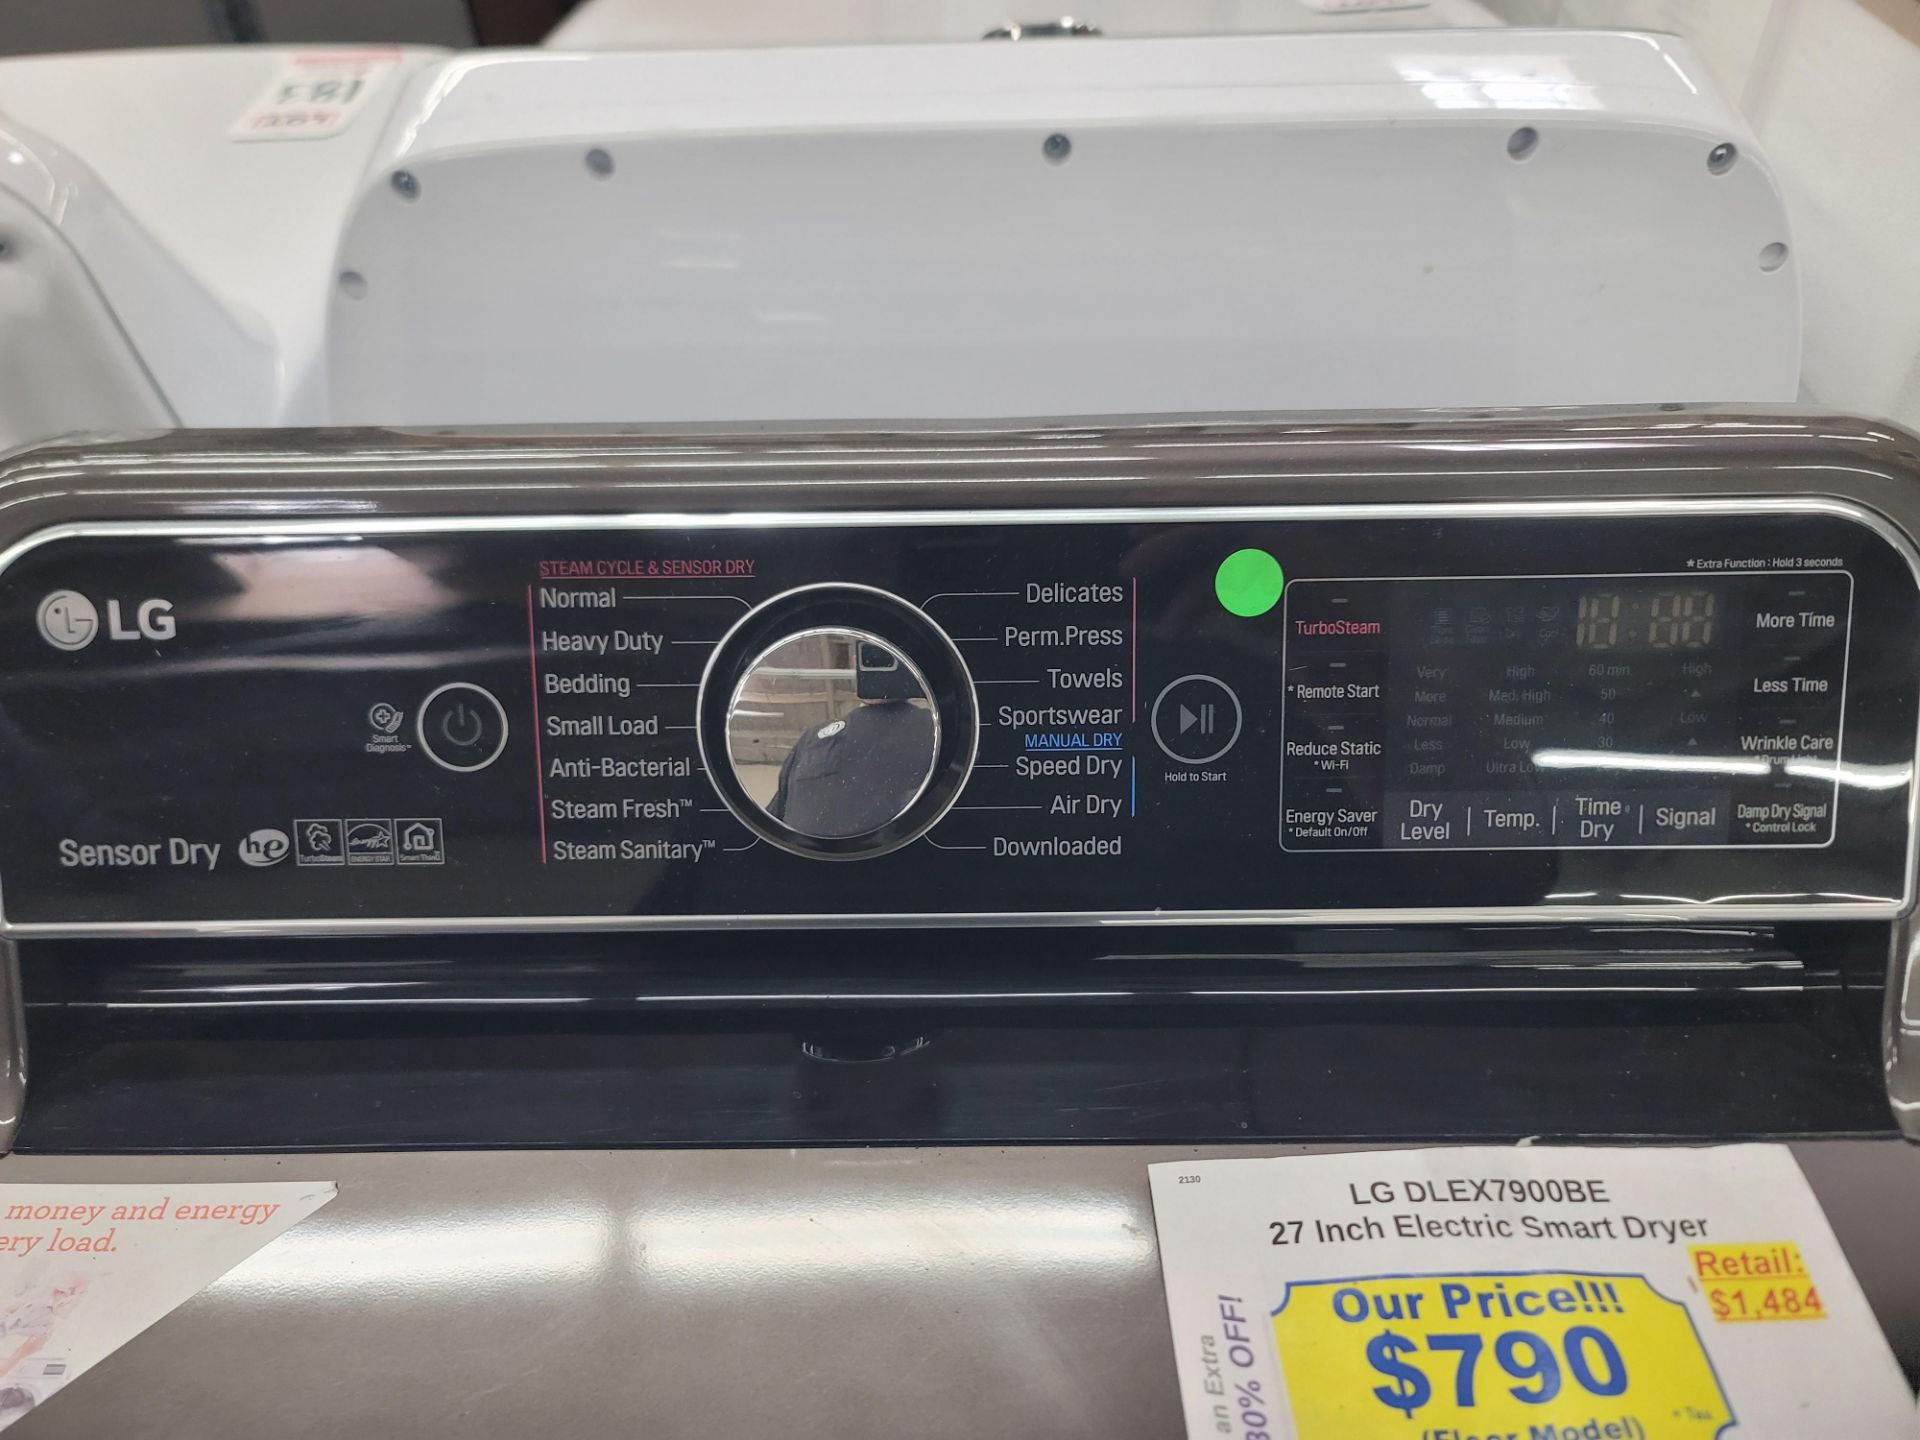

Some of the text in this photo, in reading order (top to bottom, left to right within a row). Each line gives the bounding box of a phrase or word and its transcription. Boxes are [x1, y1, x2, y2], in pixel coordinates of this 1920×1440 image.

[540, 559, 756, 576] STEAM CYCLE & SENSOR DRY
[1697, 558, 1722, 569] Extra
[1724, 558, 1765, 569] Function
[1772, 557, 1793, 568] Hold
[1796, 558, 1802, 567] 3
[1803, 557, 1843, 568] seconds
[540, 587, 616, 609] Normal
[1026, 583, 1124, 604] Delicates
[107, 598, 177, 640] LG
[1295, 619, 1381, 636] TurboSteam
[1756, 611, 1836, 629] More Time
[542, 630, 664, 655] Heavy Duty
[1005, 625, 1123, 647] Perm.Press
[1047, 667, 1123, 689] Towels
[1416, 665, 1449, 680] Very
[1506, 665, 1536, 680] High
[1588, 663, 1605, 677] 60
[1682, 662, 1713, 678] High
[545, 673, 631, 697] Bedding
[1297, 683, 1380, 699] Remote Start
[1600, 687, 1616, 700] 50
[1753, 677, 1829, 693] Less Time
[1414, 689, 1447, 703] More
[1521, 688, 1551, 704] High
[547, 715, 659, 737] Small Load
[999, 706, 1123, 730] Sportswear
[1406, 714, 1452, 728] Normal
[1494, 713, 1544, 727] Medium
[1599, 712, 1615, 725] 40
[1680, 711, 1709, 724] Low
[372, 734, 399, 743] Smart
[1025, 733, 1123, 748] MANUAL DRY
[1414, 738, 1443, 751] Less
[1503, 737, 1531, 750] Low
[1598, 736, 1614, 749] 30
[1740, 735, 1834, 751] Wrinkle Care
[1286, 740, 1382, 757] Reduce Static
[550, 757, 690, 778] Anti-Bacterial
[1016, 755, 1123, 779] Speed Dry
[1321, 760, 1349, 771] Wi-Fi
[1409, 762, 1447, 777] Damp
[1486, 760, 1546, 774] Ultra Low
[1164, 771, 1227, 783] Hold to Start
[552, 799, 617, 820] Steam
[1050, 794, 1122, 819] Air Dry
[1409, 799, 1444, 822] Dry
[1575, 797, 1621, 817] Time
[1737, 802, 1828, 821] Damp Dry Signal
[1286, 808, 1378, 826] Energy Saver
[1484, 809, 1540, 830] Temp.
[1655, 807, 1716, 830] Signal
[1295, 826, 1369, 838] Default On/Off
[1401, 822, 1450, 840] Level
[1580, 820, 1615, 842] Dry
[1752, 822, 1816, 833] Control Lock
[59, 837, 221, 871] Sensor Dry
[553, 840, 617, 861] Steam
[993, 836, 1122, 857] Downloaded
[1178, 1175, 1201, 1184] 2130
[1349, 1179, 1611, 1205] LG DLEX7900BE
[4, 1197, 280, 1226] money and energy
[1269, 1213, 1708, 1245] 27 Inch Electric Smart Dryer
[0, 1227, 117, 1257] ery load.
[1694, 1248, 1805, 1277] Retail:
[1332, 1280, 1625, 1323] Our Price!!!
[1709, 1286, 1823, 1320] $1,484
[1218, 1294, 1254, 1368] OFF!
[1366, 1325, 1628, 1419] $790
[1200, 1334, 1232, 1435] an Extra
